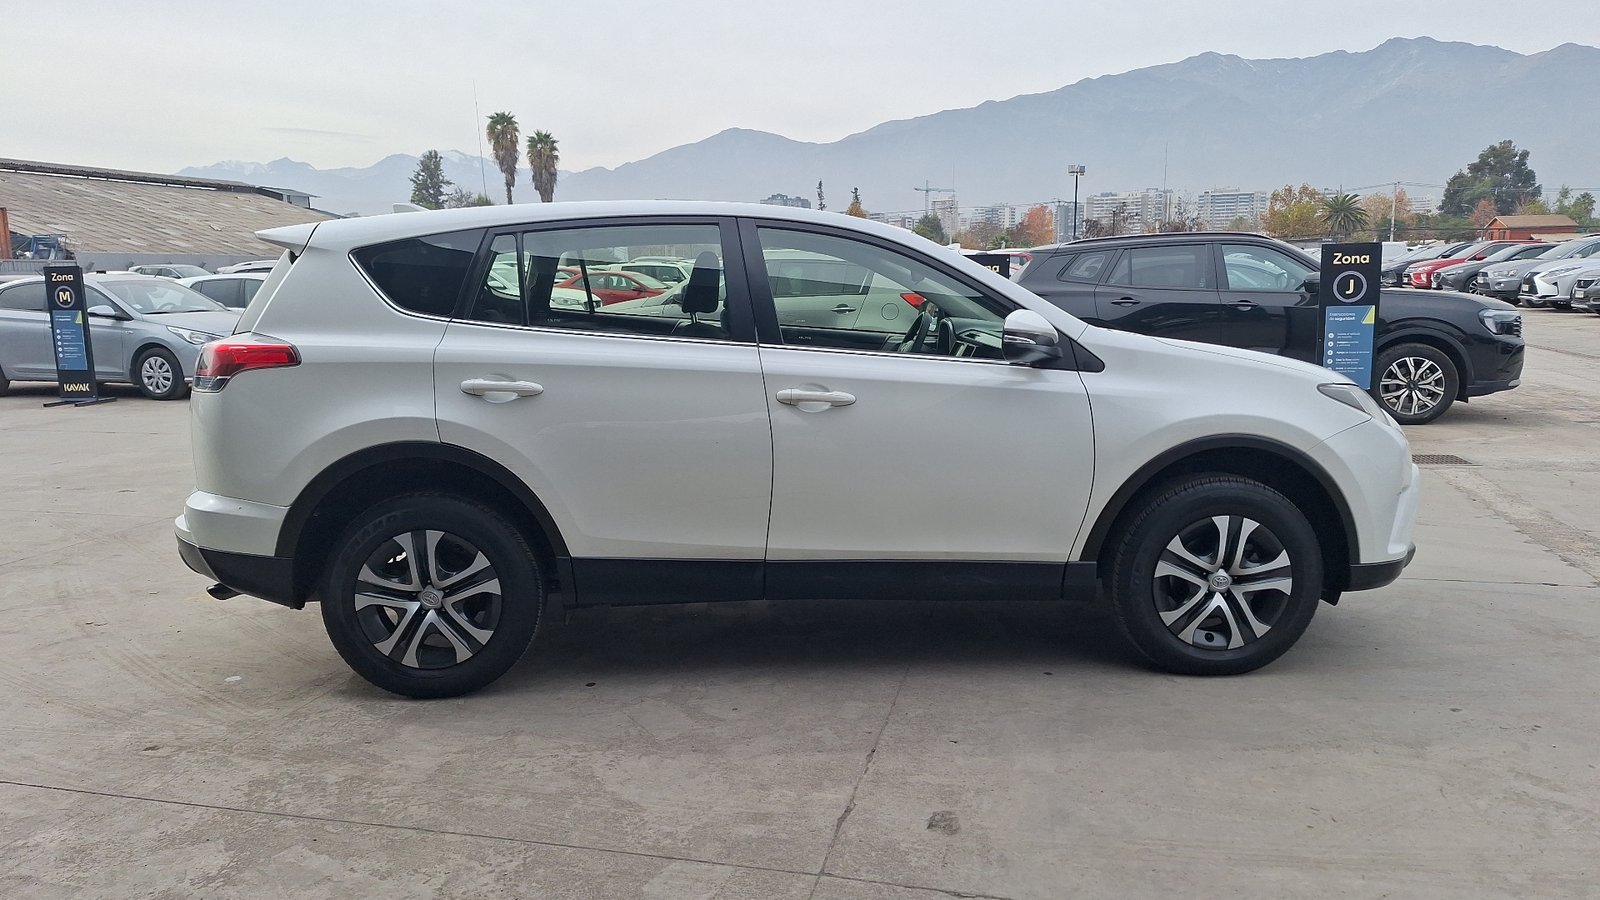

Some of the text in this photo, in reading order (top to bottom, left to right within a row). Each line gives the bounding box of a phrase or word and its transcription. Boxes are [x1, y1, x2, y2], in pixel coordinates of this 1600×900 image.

[1332, 252, 1370, 264] Zona
[51, 272, 74, 282] Zona
[1346, 279, 1354, 294] J
[59, 292, 70, 302] M
[63, 383, 90, 392] KAVAK
